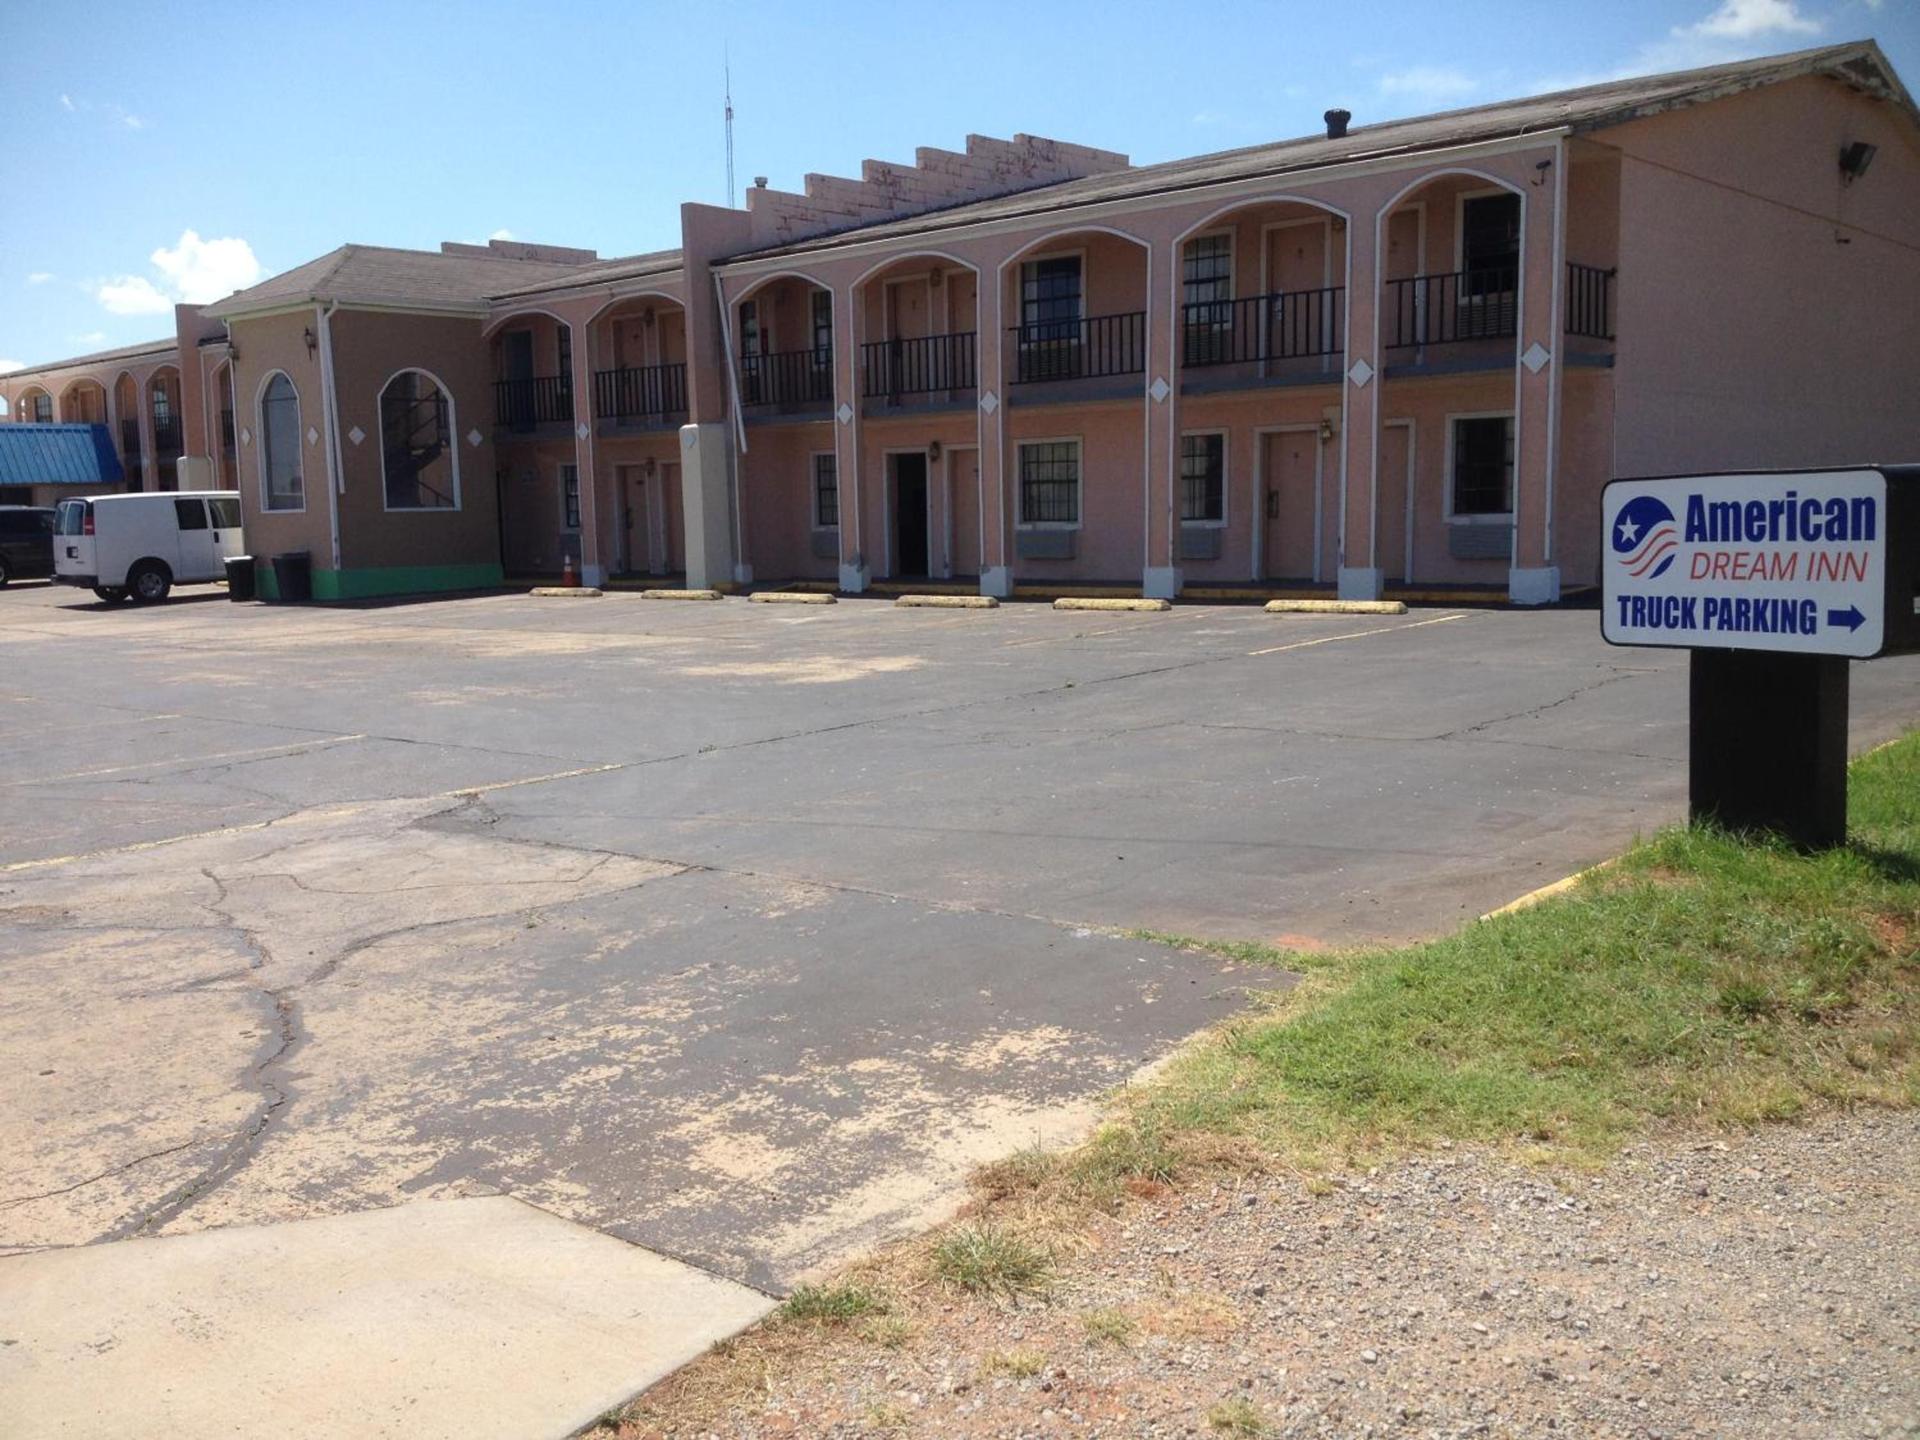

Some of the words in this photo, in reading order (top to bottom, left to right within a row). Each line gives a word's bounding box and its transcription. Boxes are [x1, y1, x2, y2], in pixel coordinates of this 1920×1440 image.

[1685, 491, 1876, 542] American
[1690, 552, 1798, 581] DREAM
[1806, 552, 1868, 582] INN
[1617, 595, 1697, 629] TRUCK
[1702, 597, 1817, 635] PARKING
